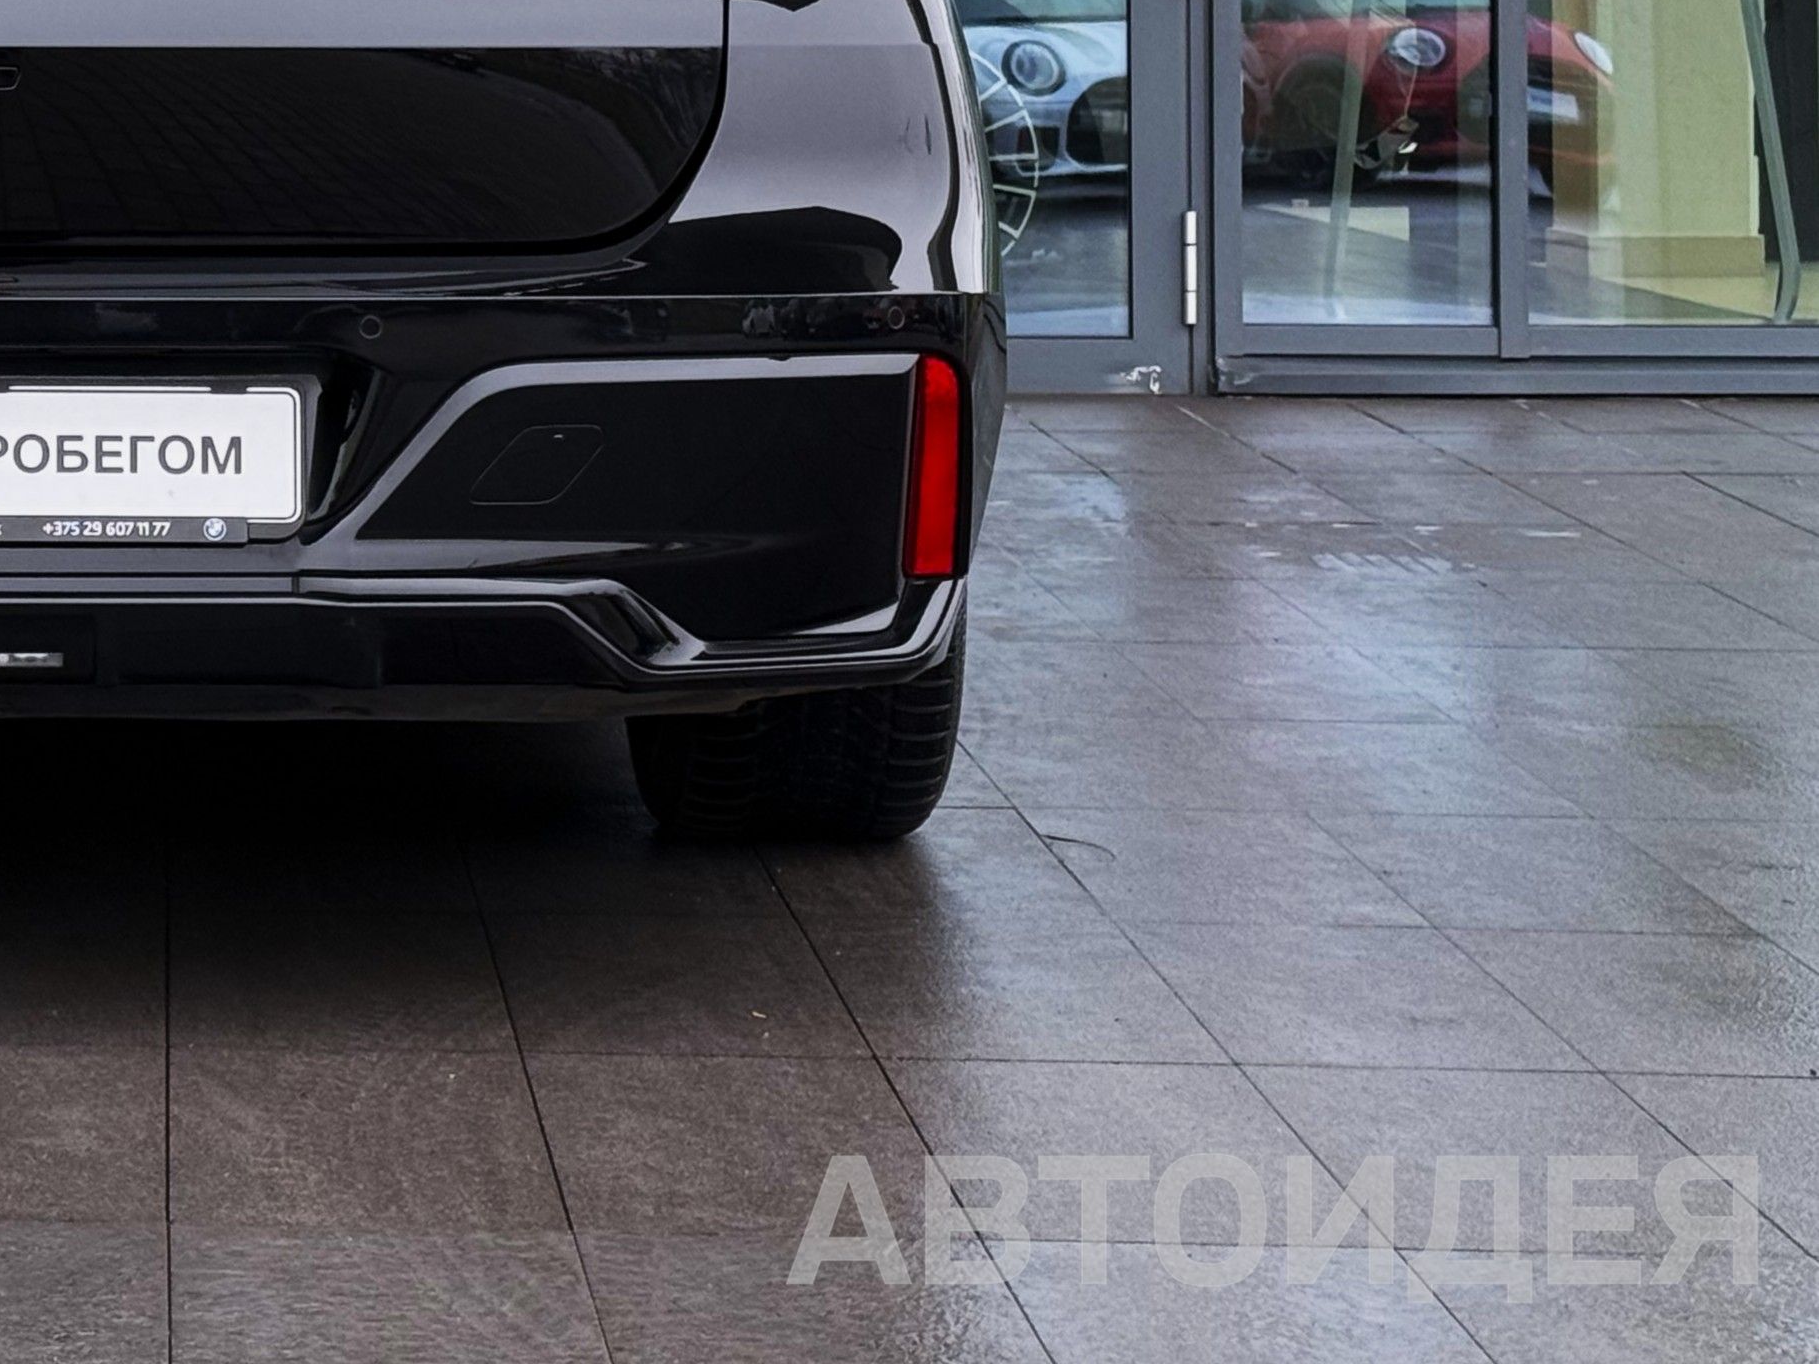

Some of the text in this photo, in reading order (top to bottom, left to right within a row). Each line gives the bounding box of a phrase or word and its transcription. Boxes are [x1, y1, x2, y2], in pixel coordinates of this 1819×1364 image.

[42, 520, 80, 537] +375
[82, 521, 103, 537] 29
[105, 521, 134, 537] 607
[152, 521, 172, 537] 77
